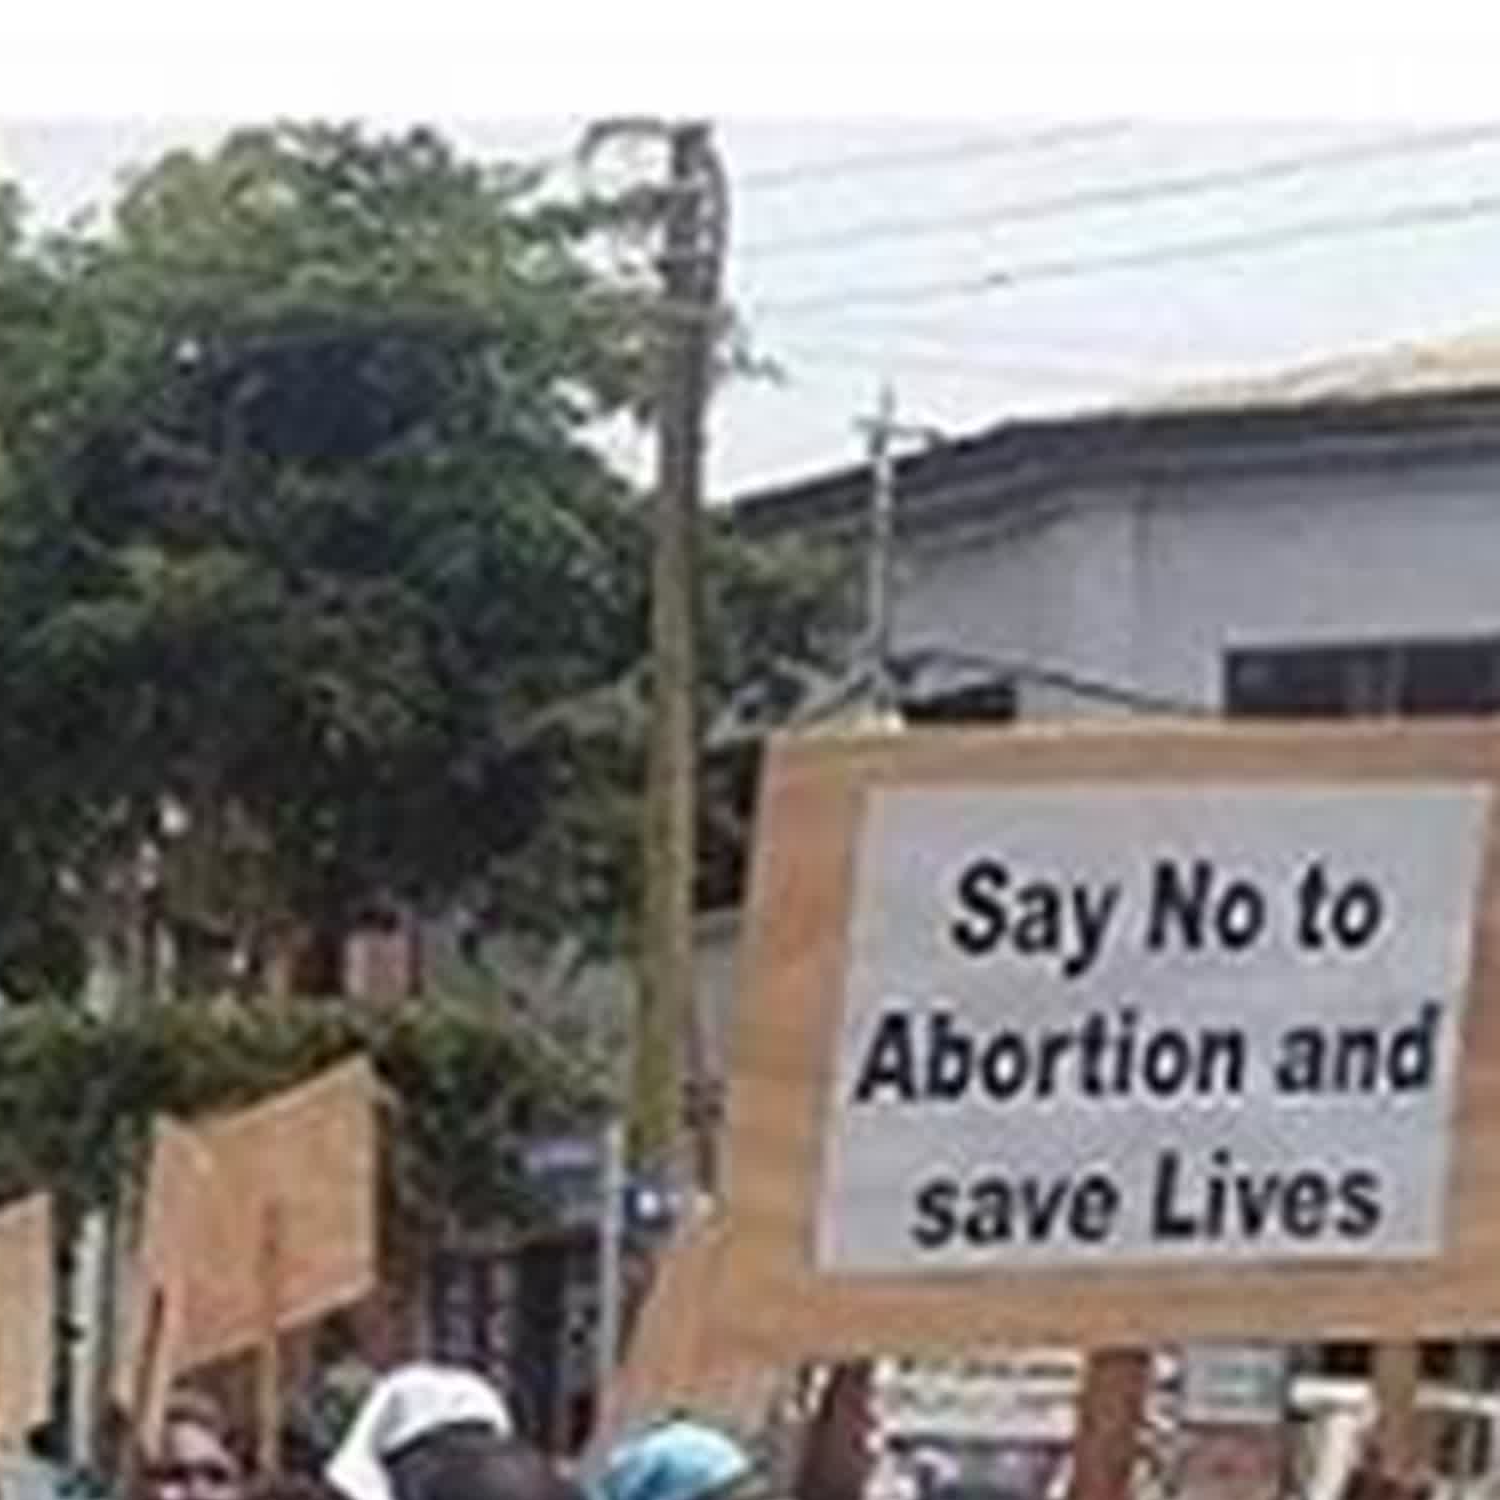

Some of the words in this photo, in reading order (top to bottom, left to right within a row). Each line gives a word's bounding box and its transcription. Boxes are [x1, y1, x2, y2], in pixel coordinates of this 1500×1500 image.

[950, 859, 1120, 979] Say
[1145, 859, 1266, 952] No
[1297, 862, 1383, 951] to
[853, 1007, 1246, 1104] Abortion
[1274, 1001, 1442, 1094] and
[912, 1174, 1120, 1249] save
[1151, 1148, 1381, 1242] Lives
